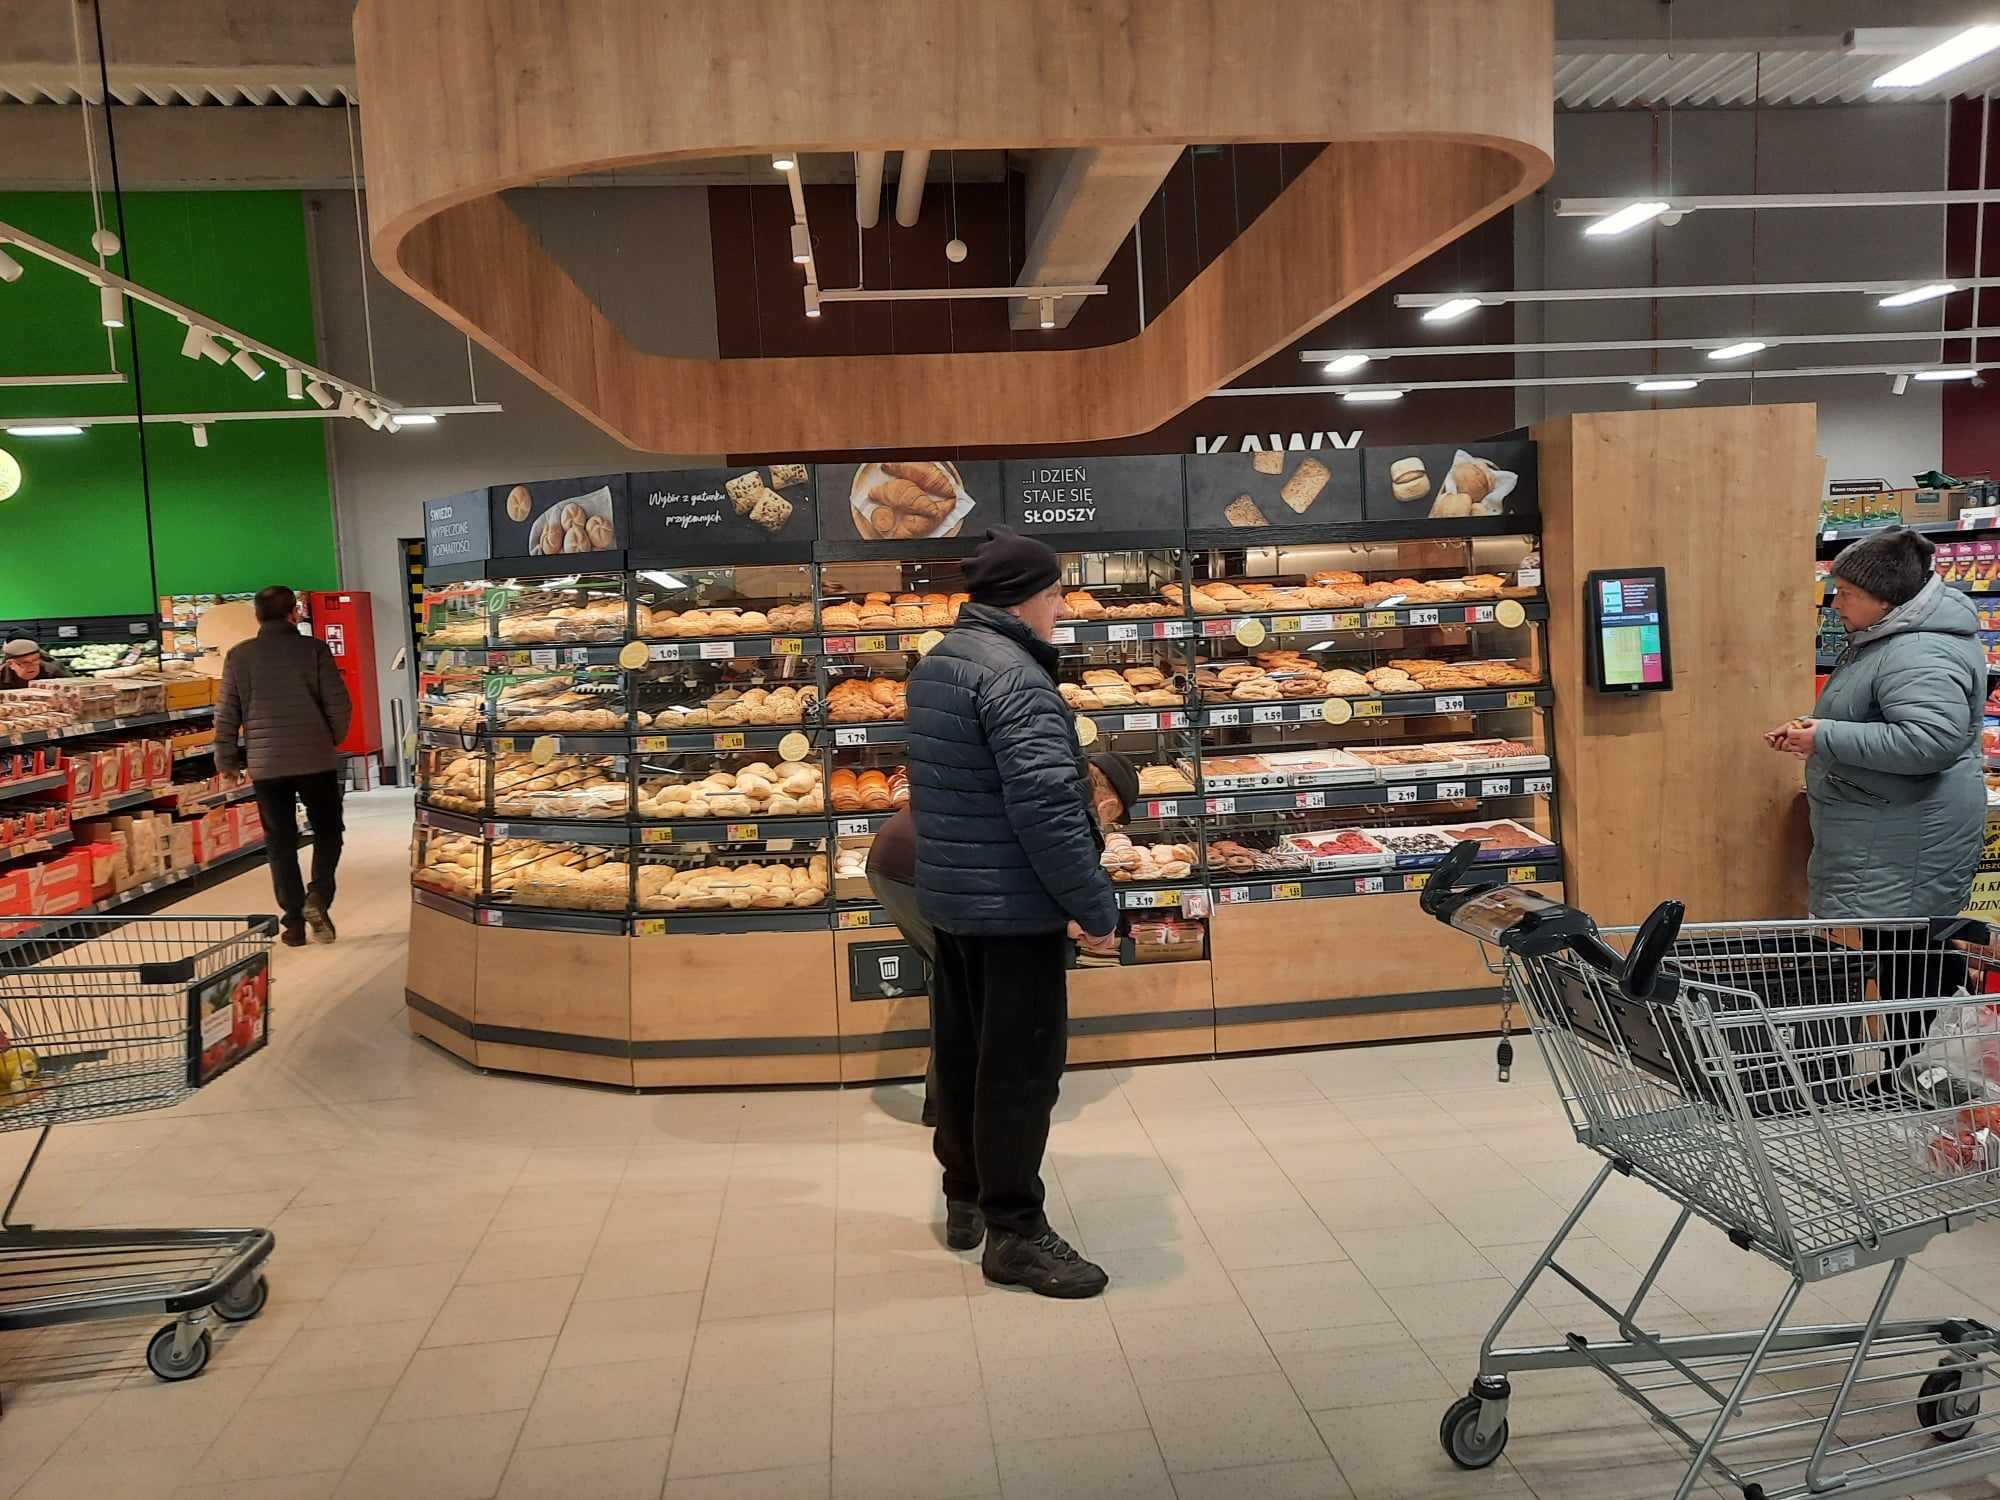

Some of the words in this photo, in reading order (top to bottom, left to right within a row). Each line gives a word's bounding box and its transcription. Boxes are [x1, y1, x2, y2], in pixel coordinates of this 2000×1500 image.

[1040, 466, 1086, 483] DZIEŃ
[1023, 489, 1066, 503] STAJE
[1070, 488, 1093, 504] SIĘ
[1024, 508, 1096, 523] SŁODSZY
[1420, 613, 1438, 623] 3.99
[660, 650, 678, 659] 1.09
[1445, 701, 1463, 711] 3.99
[1221, 713, 1239, 724] 1.59
[1264, 711, 1281, 721] 1.59
[848, 734, 866, 743] 1.79
[1492, 784, 1509, 794] 1.99
[1532, 782, 1551, 792] 2.69
[1398, 791, 1416, 801] 2.19
[1446, 788, 1464, 797] 2.69
[850, 824, 868, 834] 1.25
[1135, 896, 1153, 907] 3.19
